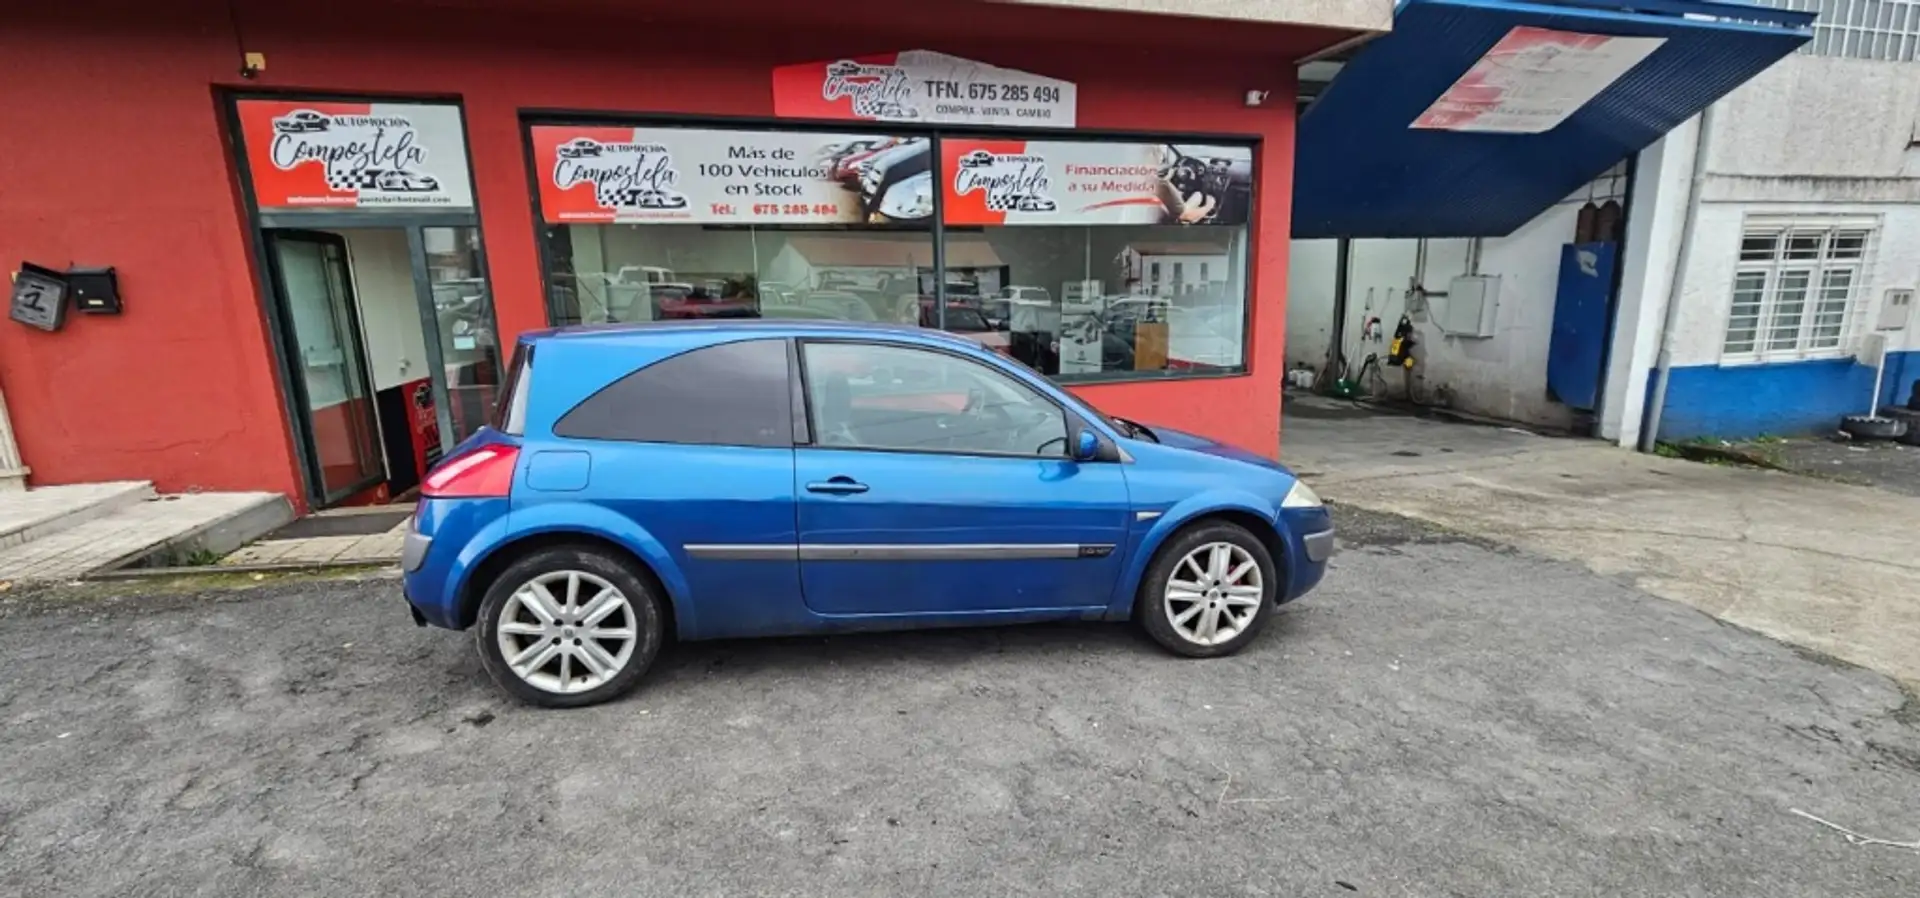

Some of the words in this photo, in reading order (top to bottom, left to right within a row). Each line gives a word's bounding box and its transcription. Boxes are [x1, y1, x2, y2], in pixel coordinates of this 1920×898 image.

[924, 80, 963, 99] TFN.
[968, 83, 997, 100] 675
[1001, 84, 1029, 102] 285
[1033, 86, 1060, 103] 494
[935, 104, 974, 115] COMPRA
[981, 107, 1010, 117] VENTA
[1016, 108, 1051, 118] CAMBIO
[273, 127, 425, 176] Compostela
[728, 146, 766, 159] Más
[771, 147, 795, 160] de
[555, 153, 677, 197] Compostela
[699, 163, 733, 177] 100
[724, 184, 749, 195] en
[754, 182, 802, 196] Stock
[956, 163, 1049, 203] Compostela
[1068, 182, 1077, 192] a
[1081, 183, 1098, 192] su
[1101, 181, 1155, 193] Medida
[753, 203, 779, 215] 675
